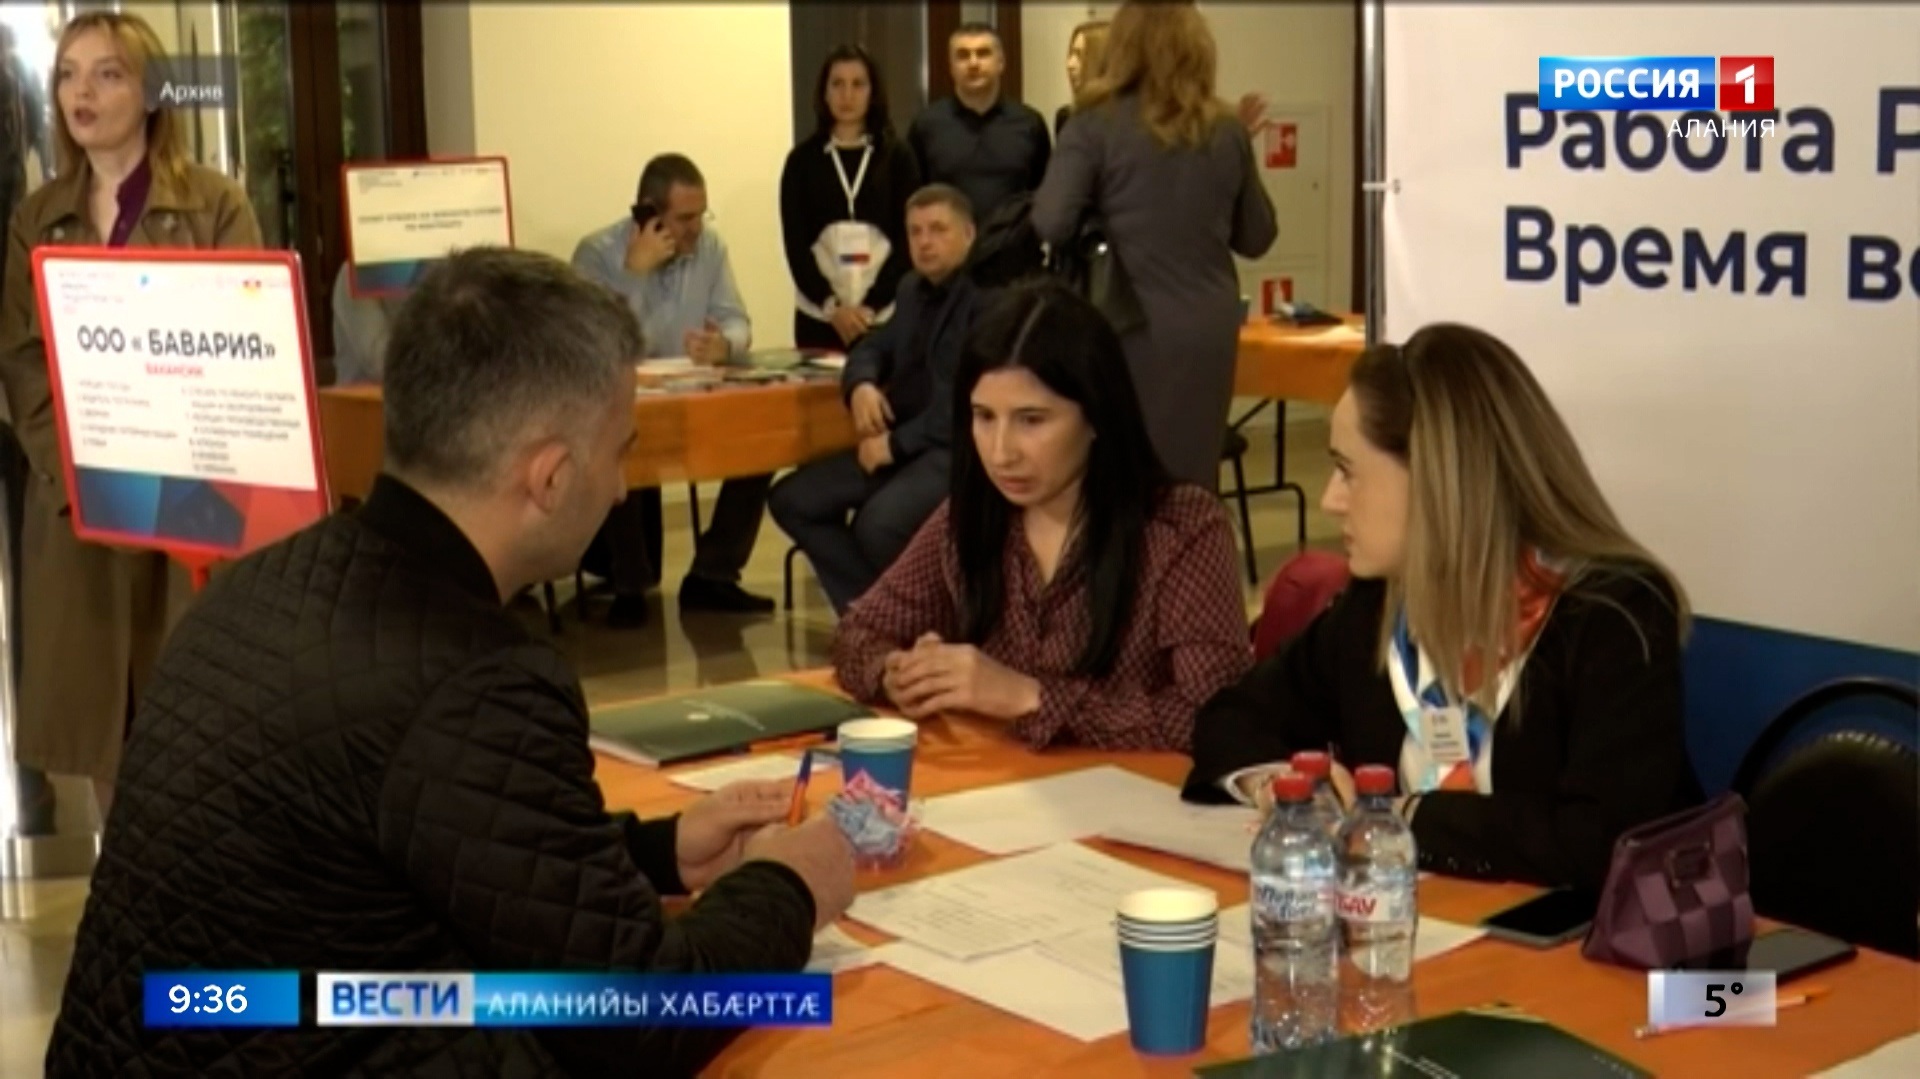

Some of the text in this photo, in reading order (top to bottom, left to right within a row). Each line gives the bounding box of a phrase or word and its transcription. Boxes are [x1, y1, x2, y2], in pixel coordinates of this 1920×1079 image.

[1505, 92, 1835, 174] Работа
[1505, 205, 1920, 306] Время в
[77, 324, 126, 354] ООО
[148, 327, 276, 361] БАВАРИЯ»
